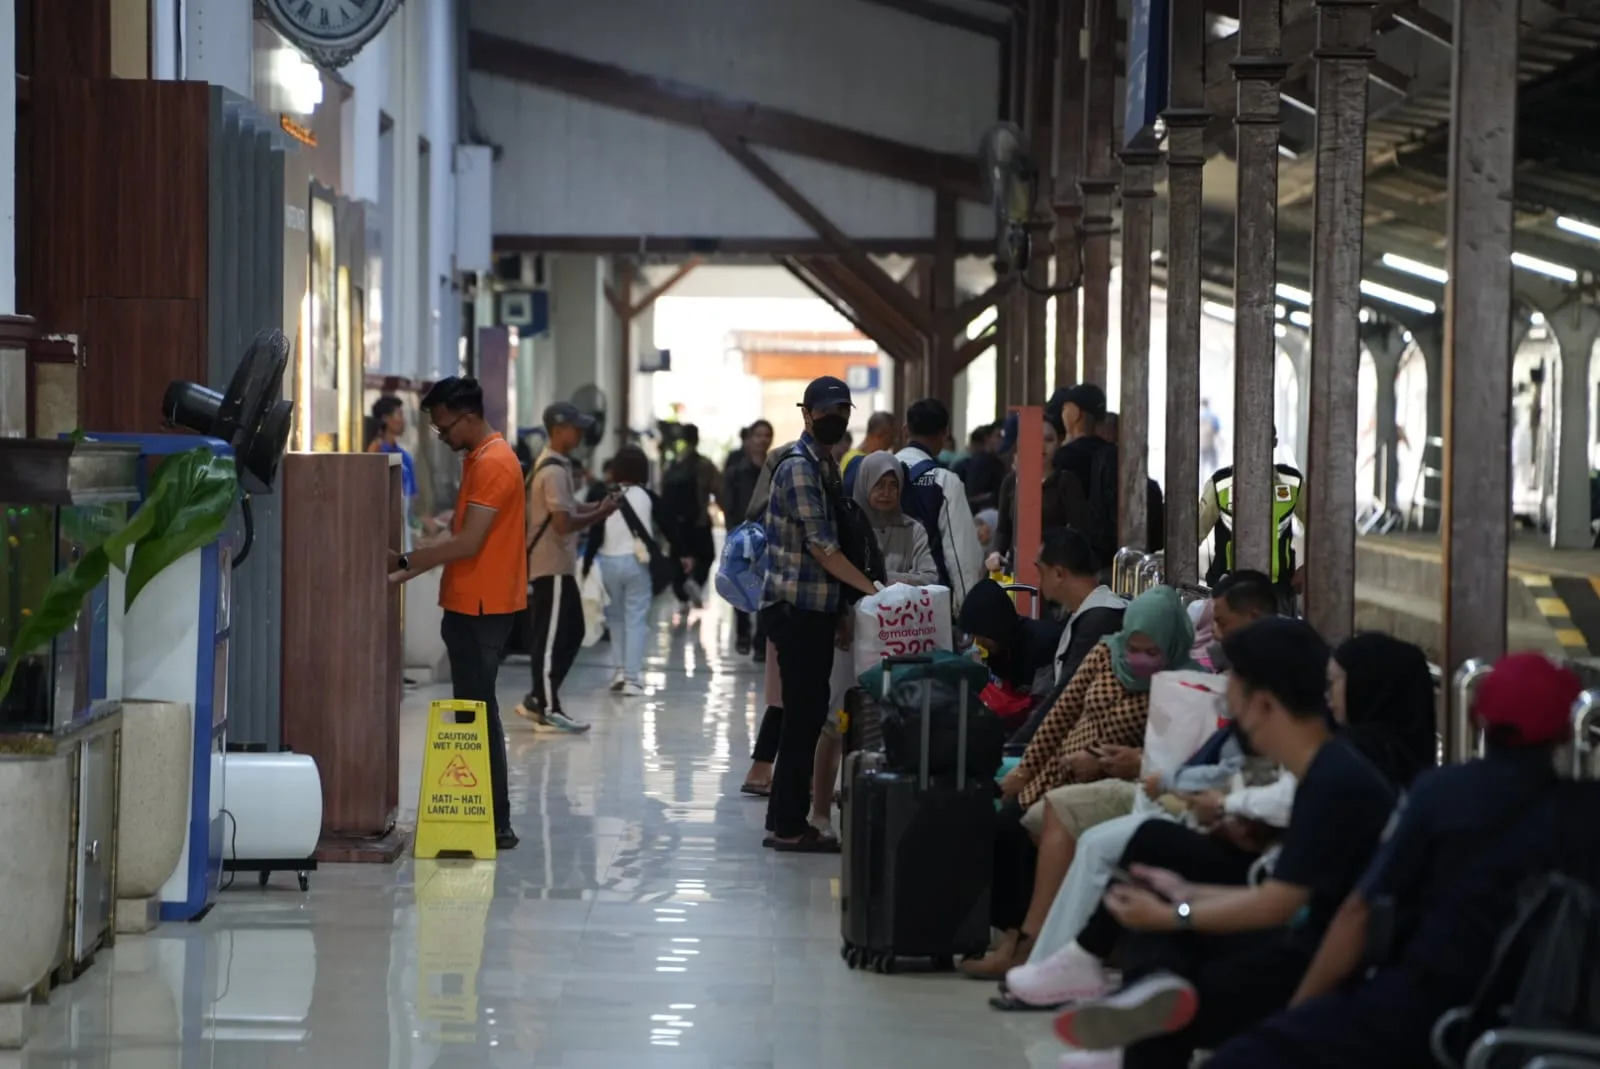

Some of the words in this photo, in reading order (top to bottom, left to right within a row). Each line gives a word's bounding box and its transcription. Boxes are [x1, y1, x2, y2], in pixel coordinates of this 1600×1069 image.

[438, 732, 478, 741] CAUTION
[433, 741, 451, 750] WET
[454, 742, 482, 751] FLOOR
[427, 804, 459, 814] LANTAI
[464, 806, 486, 816] LICIN
